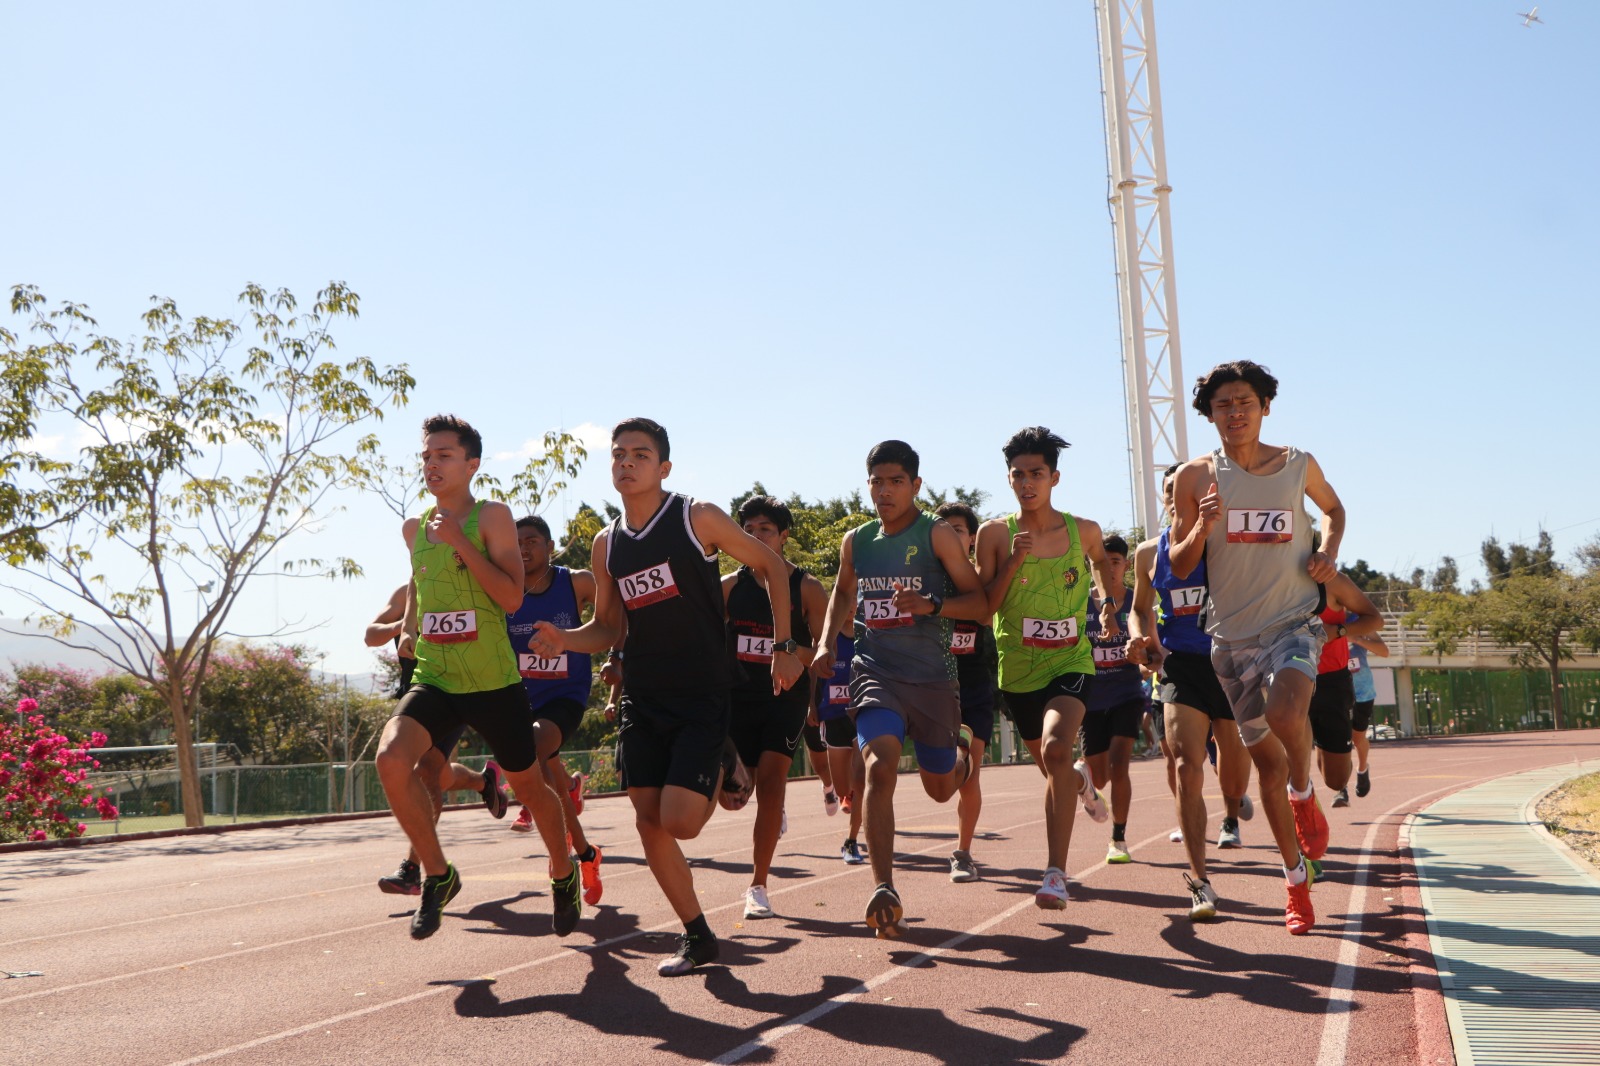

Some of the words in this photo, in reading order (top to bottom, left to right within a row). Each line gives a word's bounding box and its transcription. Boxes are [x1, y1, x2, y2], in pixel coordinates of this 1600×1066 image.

[1240, 511, 1286, 532] 176
[624, 568, 665, 598] 058
[858, 576, 923, 592] PAINANIS
[1180, 588, 1202, 606] 17
[429, 612, 467, 634] 265
[1031, 620, 1071, 639] 253
[953, 634, 972, 648] 39
[526, 655, 562, 671] 207
[1102, 648, 1126, 661] 158
